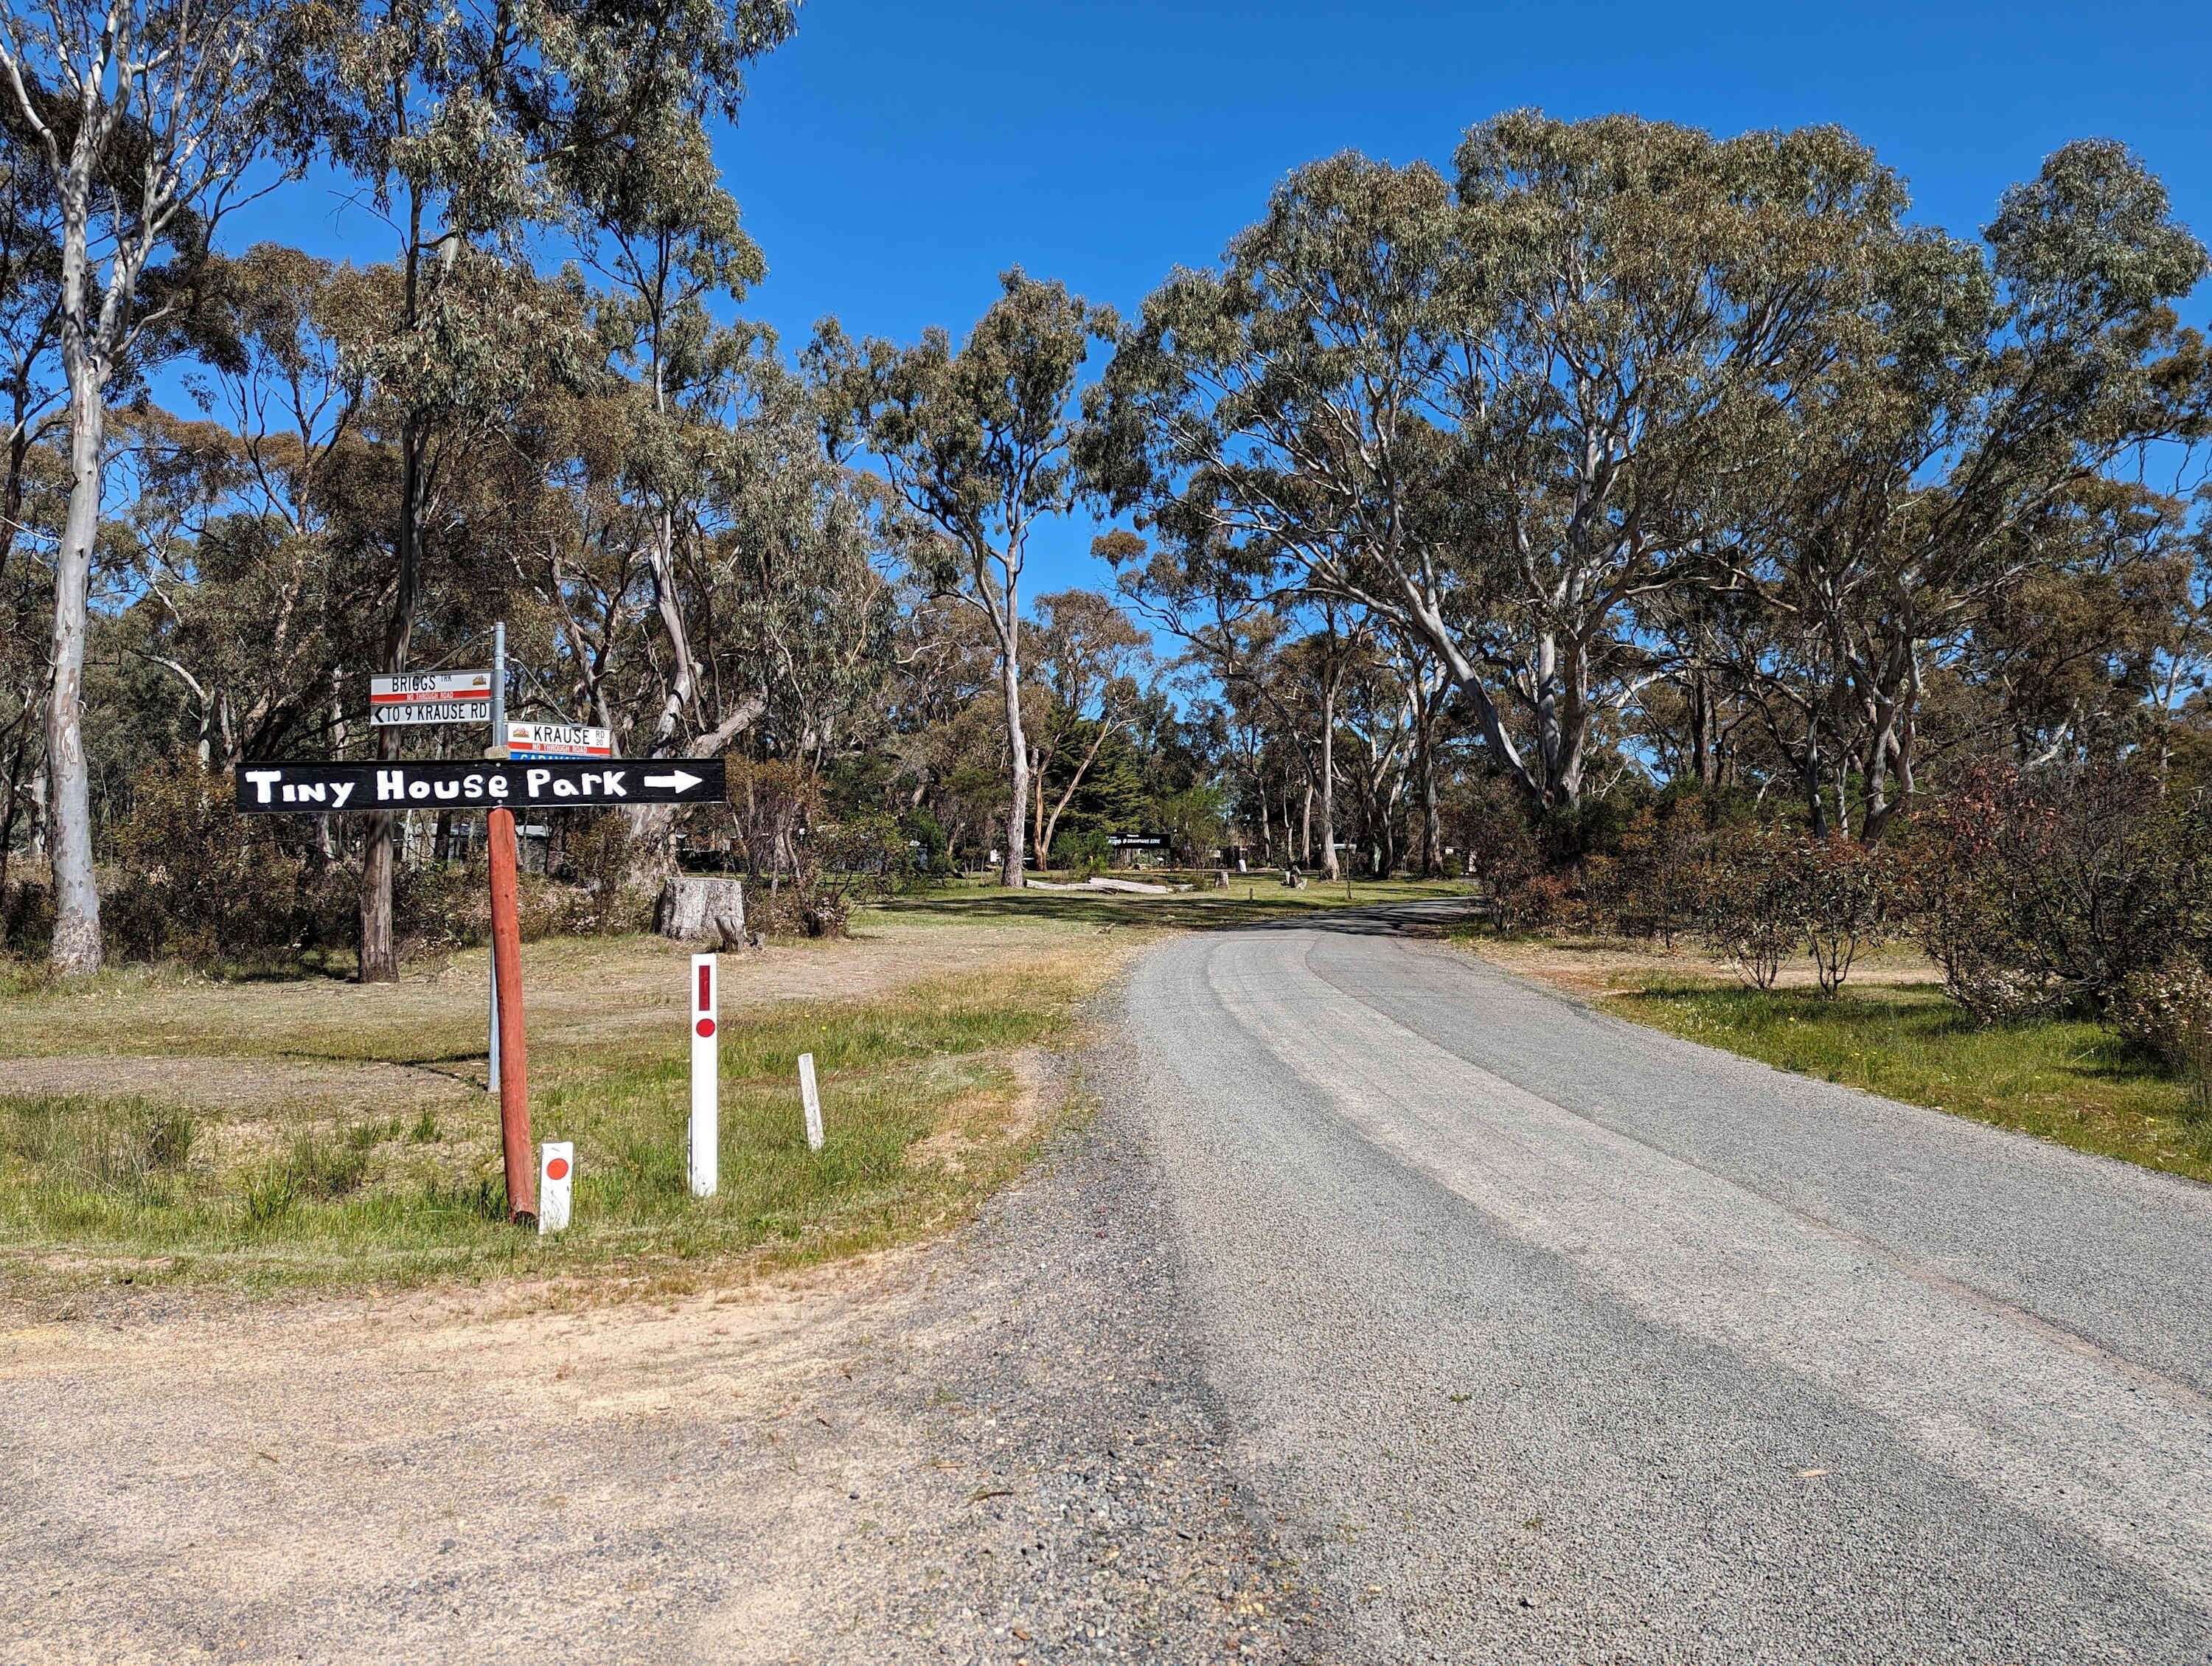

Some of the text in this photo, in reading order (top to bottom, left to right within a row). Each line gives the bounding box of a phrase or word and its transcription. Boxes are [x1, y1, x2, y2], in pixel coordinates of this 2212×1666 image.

[392, 675, 436, 693] BRIGGS
[416, 693, 438, 701] THROUGH
[440, 691, 454, 699] ROAD
[386, 702, 487, 723] TO 9 KRAUSE RD
[534, 726, 605, 745] KRAUSE RD
[532, 743, 540, 751] NO
[543, 744, 570, 753] THROUGH
[376, 769, 509, 801] House
[526, 768, 627, 798] Park
